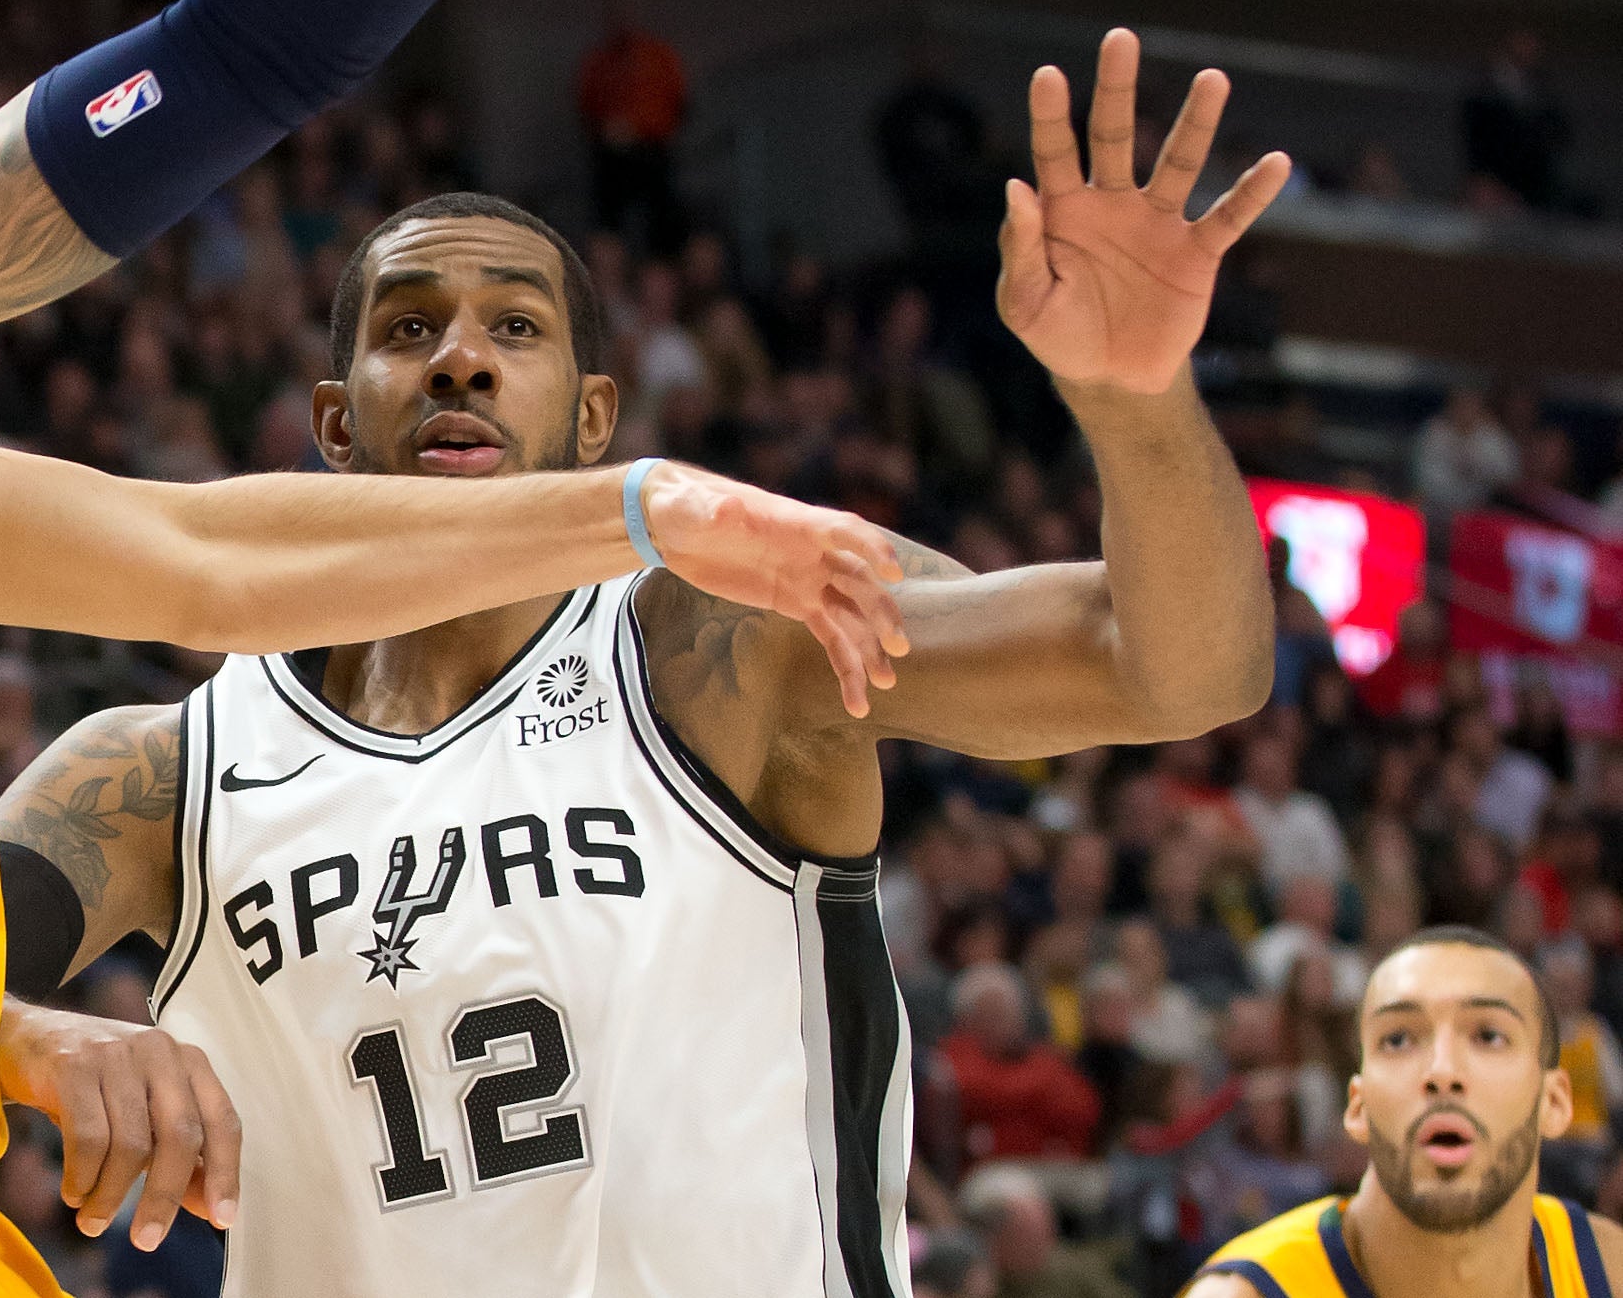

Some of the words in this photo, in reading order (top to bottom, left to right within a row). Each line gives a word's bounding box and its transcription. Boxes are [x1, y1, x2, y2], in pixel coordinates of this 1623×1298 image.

[515, 696, 609, 746] Frost
[224, 807, 645, 989] SPURS
[343, 992, 593, 1214] 12
